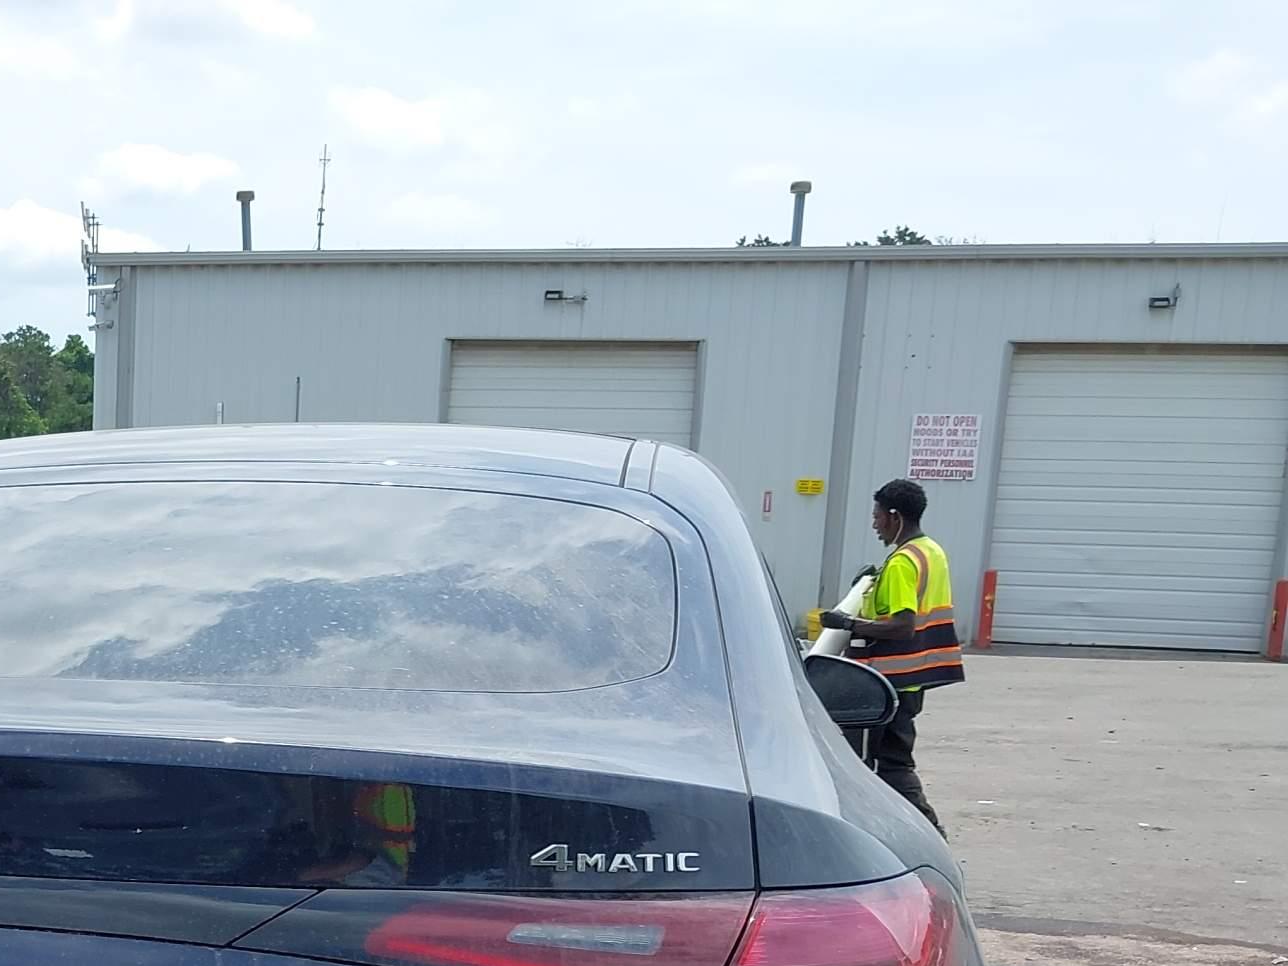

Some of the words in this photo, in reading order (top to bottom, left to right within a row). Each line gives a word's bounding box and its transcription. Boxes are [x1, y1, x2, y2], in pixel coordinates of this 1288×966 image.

[916, 415, 930, 426] DO
[932, 415, 951, 427] NOT
[952, 415, 978, 427] OPEN
[913, 428, 944, 437] HOODS
[945, 428, 959, 437] OR
[961, 428, 978, 437] TRY
[912, 438, 922, 447] TO
[923, 438, 945, 447] START
[946, 439, 978, 448] VEHICLES
[912, 448, 955, 458] WITHOUT
[957, 449, 975, 458] IAA
[909, 469, 974, 478] AUTHORIZATION
[529, 843, 701, 873] 4MATIC
